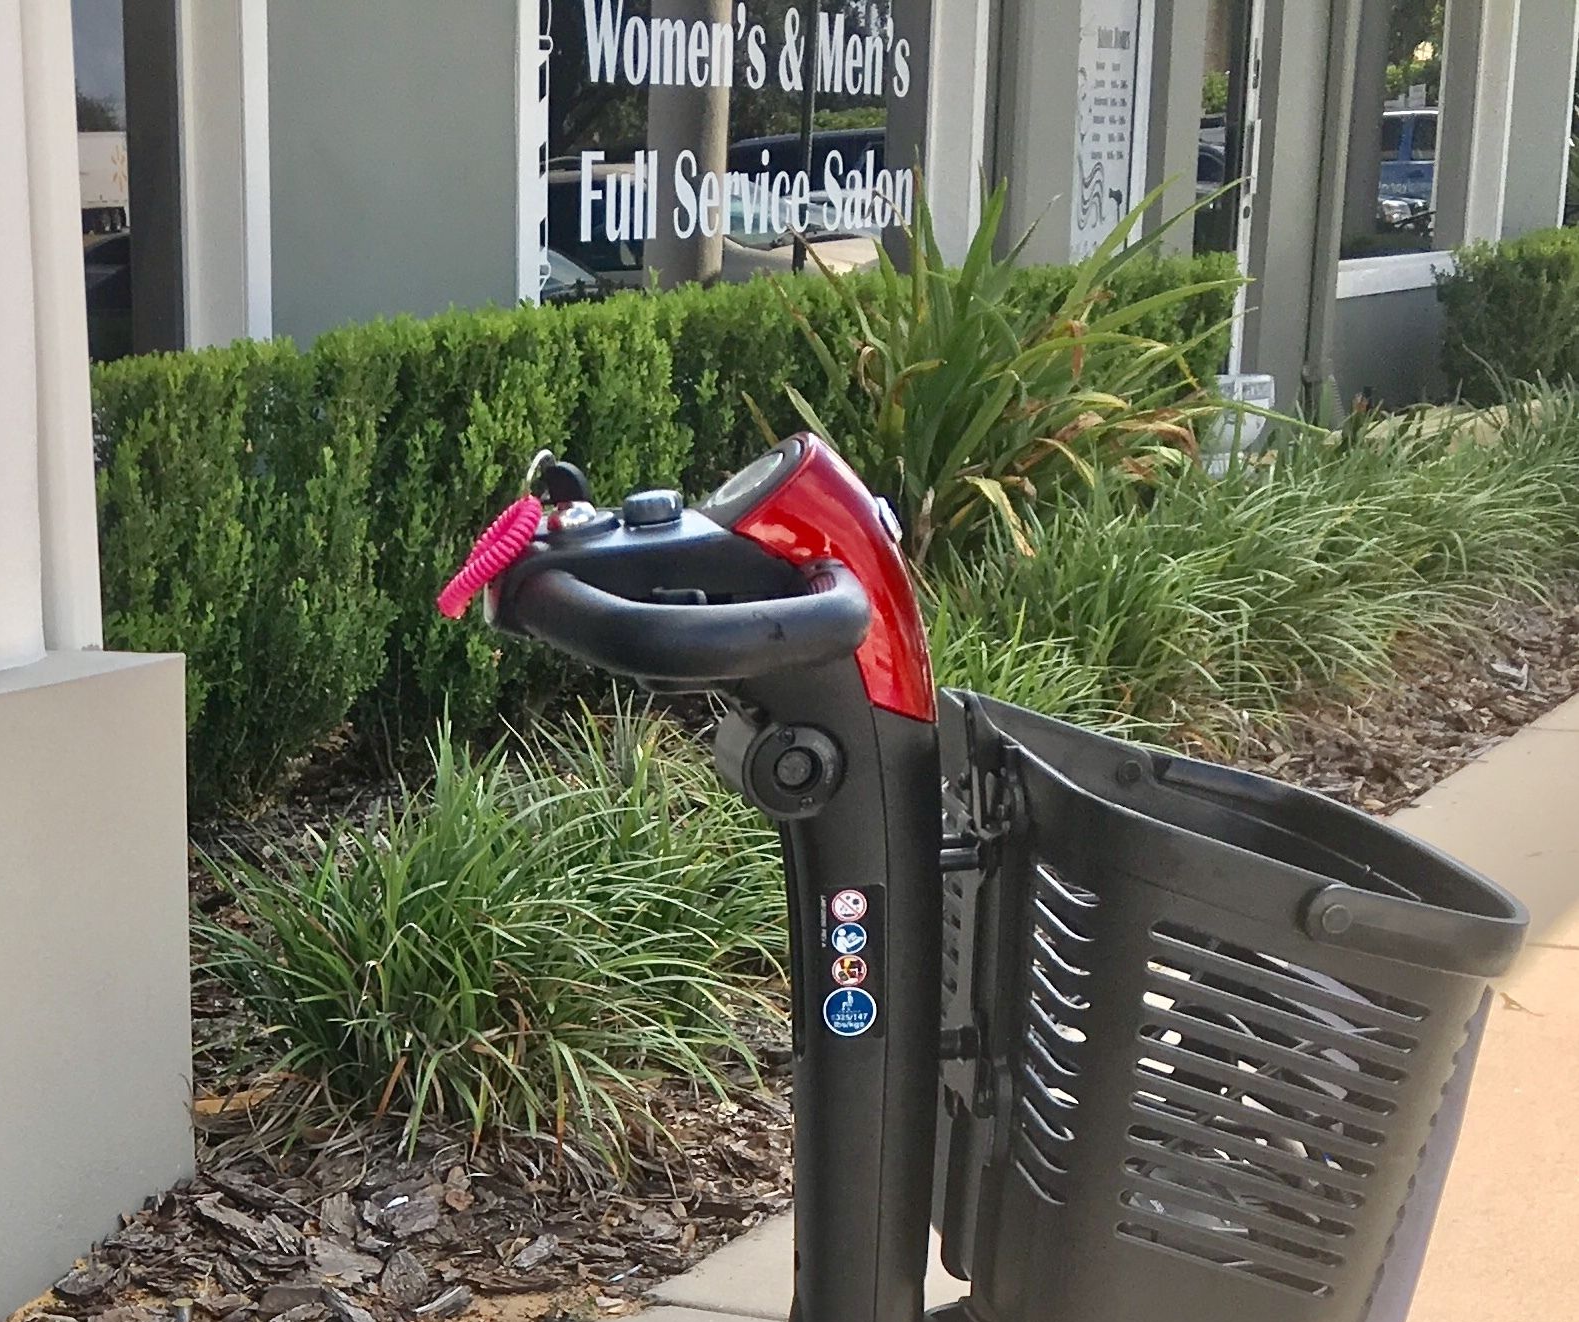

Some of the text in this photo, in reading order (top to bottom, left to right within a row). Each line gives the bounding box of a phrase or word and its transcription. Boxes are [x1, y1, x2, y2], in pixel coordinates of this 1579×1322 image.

[583, 0, 911, 98] Women's & Men's
[580, 149, 914, 243] Full Service Salon
